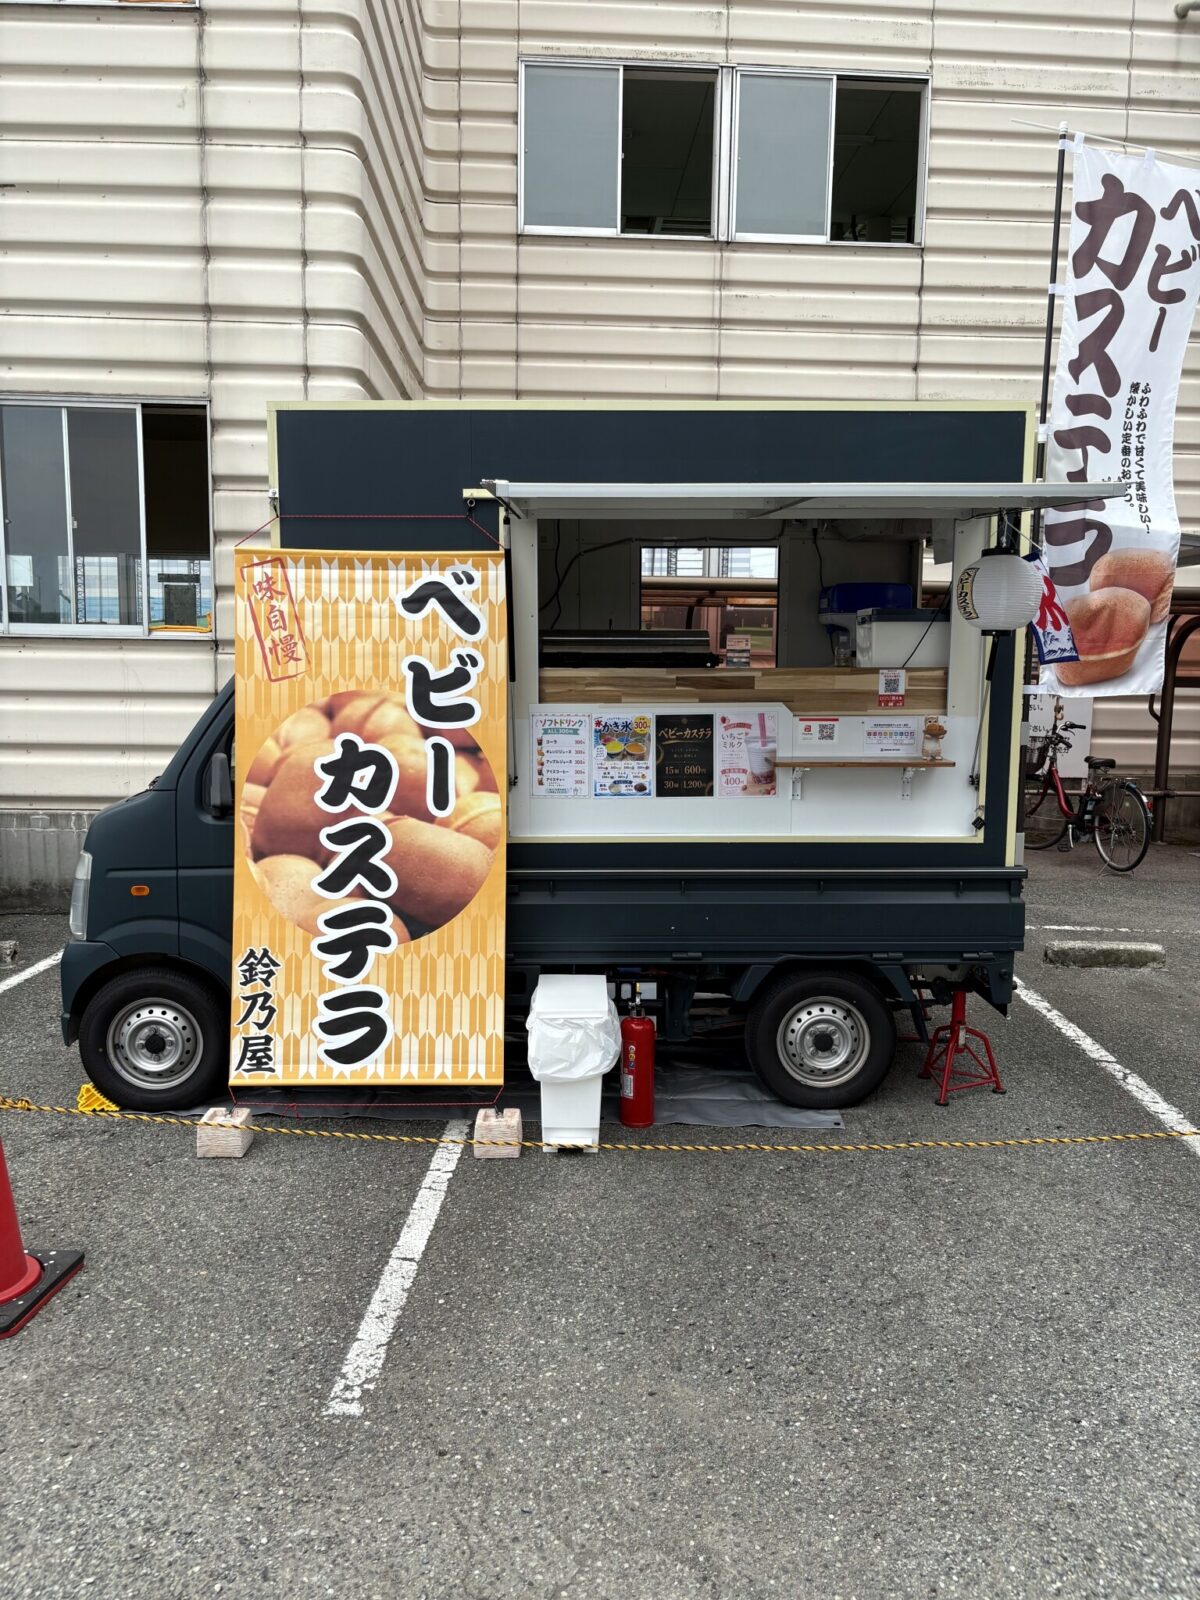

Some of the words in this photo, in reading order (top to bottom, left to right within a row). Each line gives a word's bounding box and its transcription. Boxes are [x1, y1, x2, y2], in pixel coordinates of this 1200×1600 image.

[251, 571, 303, 668] 味自慢
[400, 568, 484, 814] ベビー
[540, 719, 584, 727] ソフトドリンク
[602, 720, 633, 733] かき氷
[659, 727, 712, 739] ベビーカステラ
[721, 732, 743, 740] いちご
[722, 741, 742, 749] ミルク
[316, 737, 397, 1066] カステラ
[235, 947, 281, 1074] 鈴乃屋
